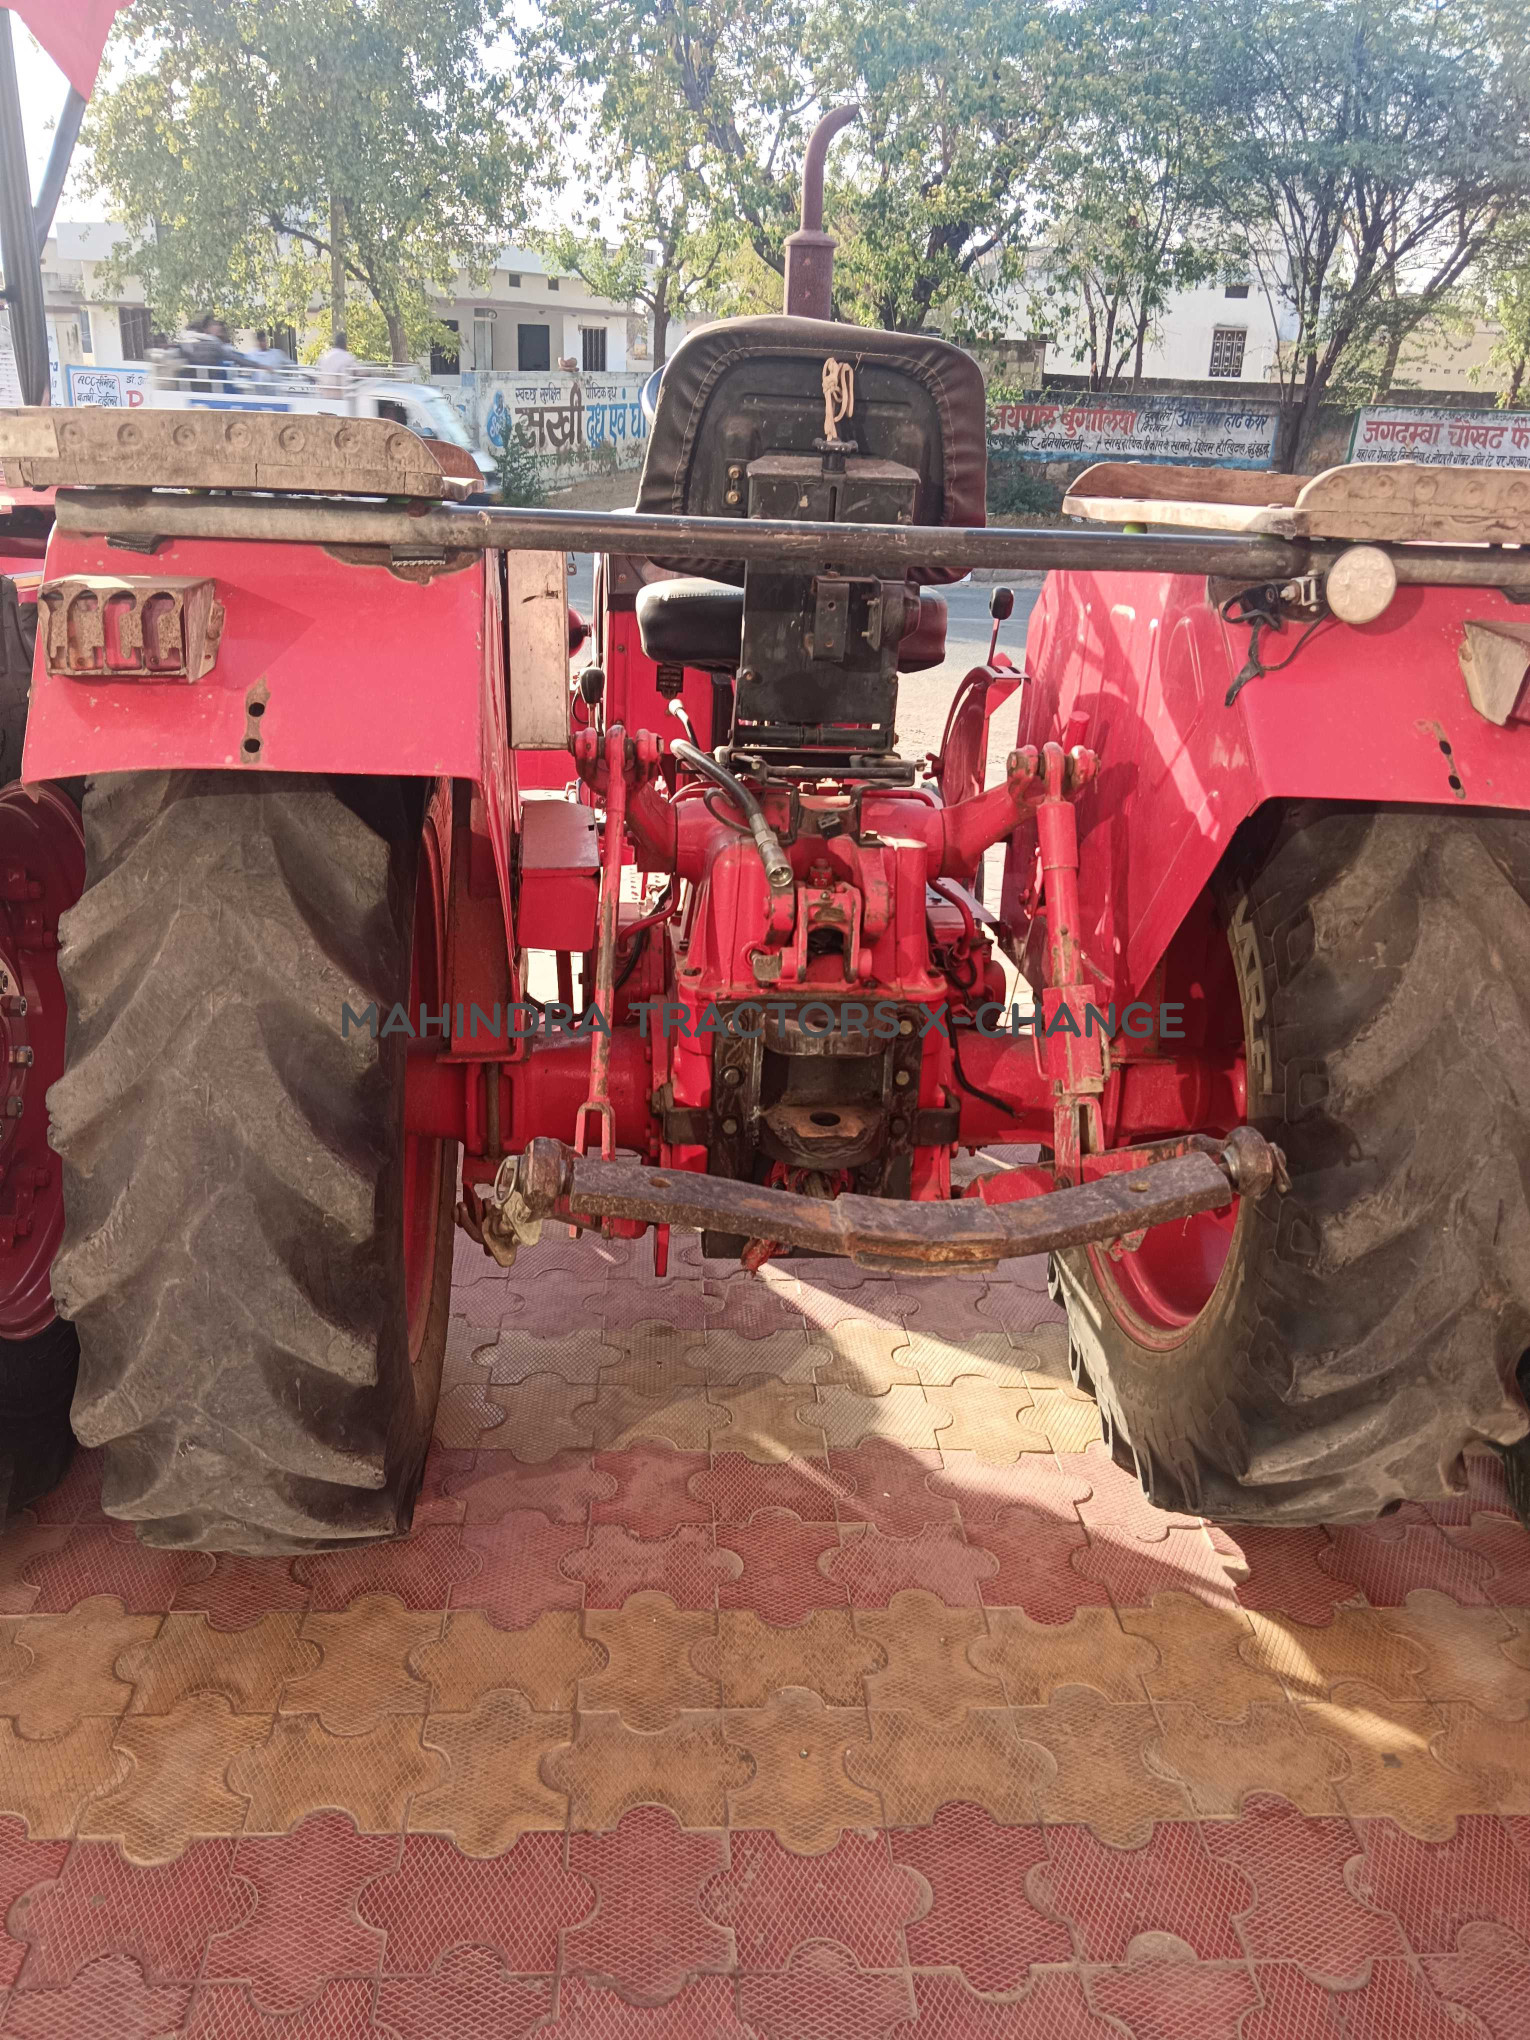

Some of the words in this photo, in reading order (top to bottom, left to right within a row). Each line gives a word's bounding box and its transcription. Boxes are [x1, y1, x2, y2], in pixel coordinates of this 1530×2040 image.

[515, 387, 538, 404] स्वच्छ
[514, 382, 585, 449] सखी
[586, 403, 608, 449] दूध
[609, 387, 628, 446] एवं
[1363, 421, 1444, 448] जगदम्बा
